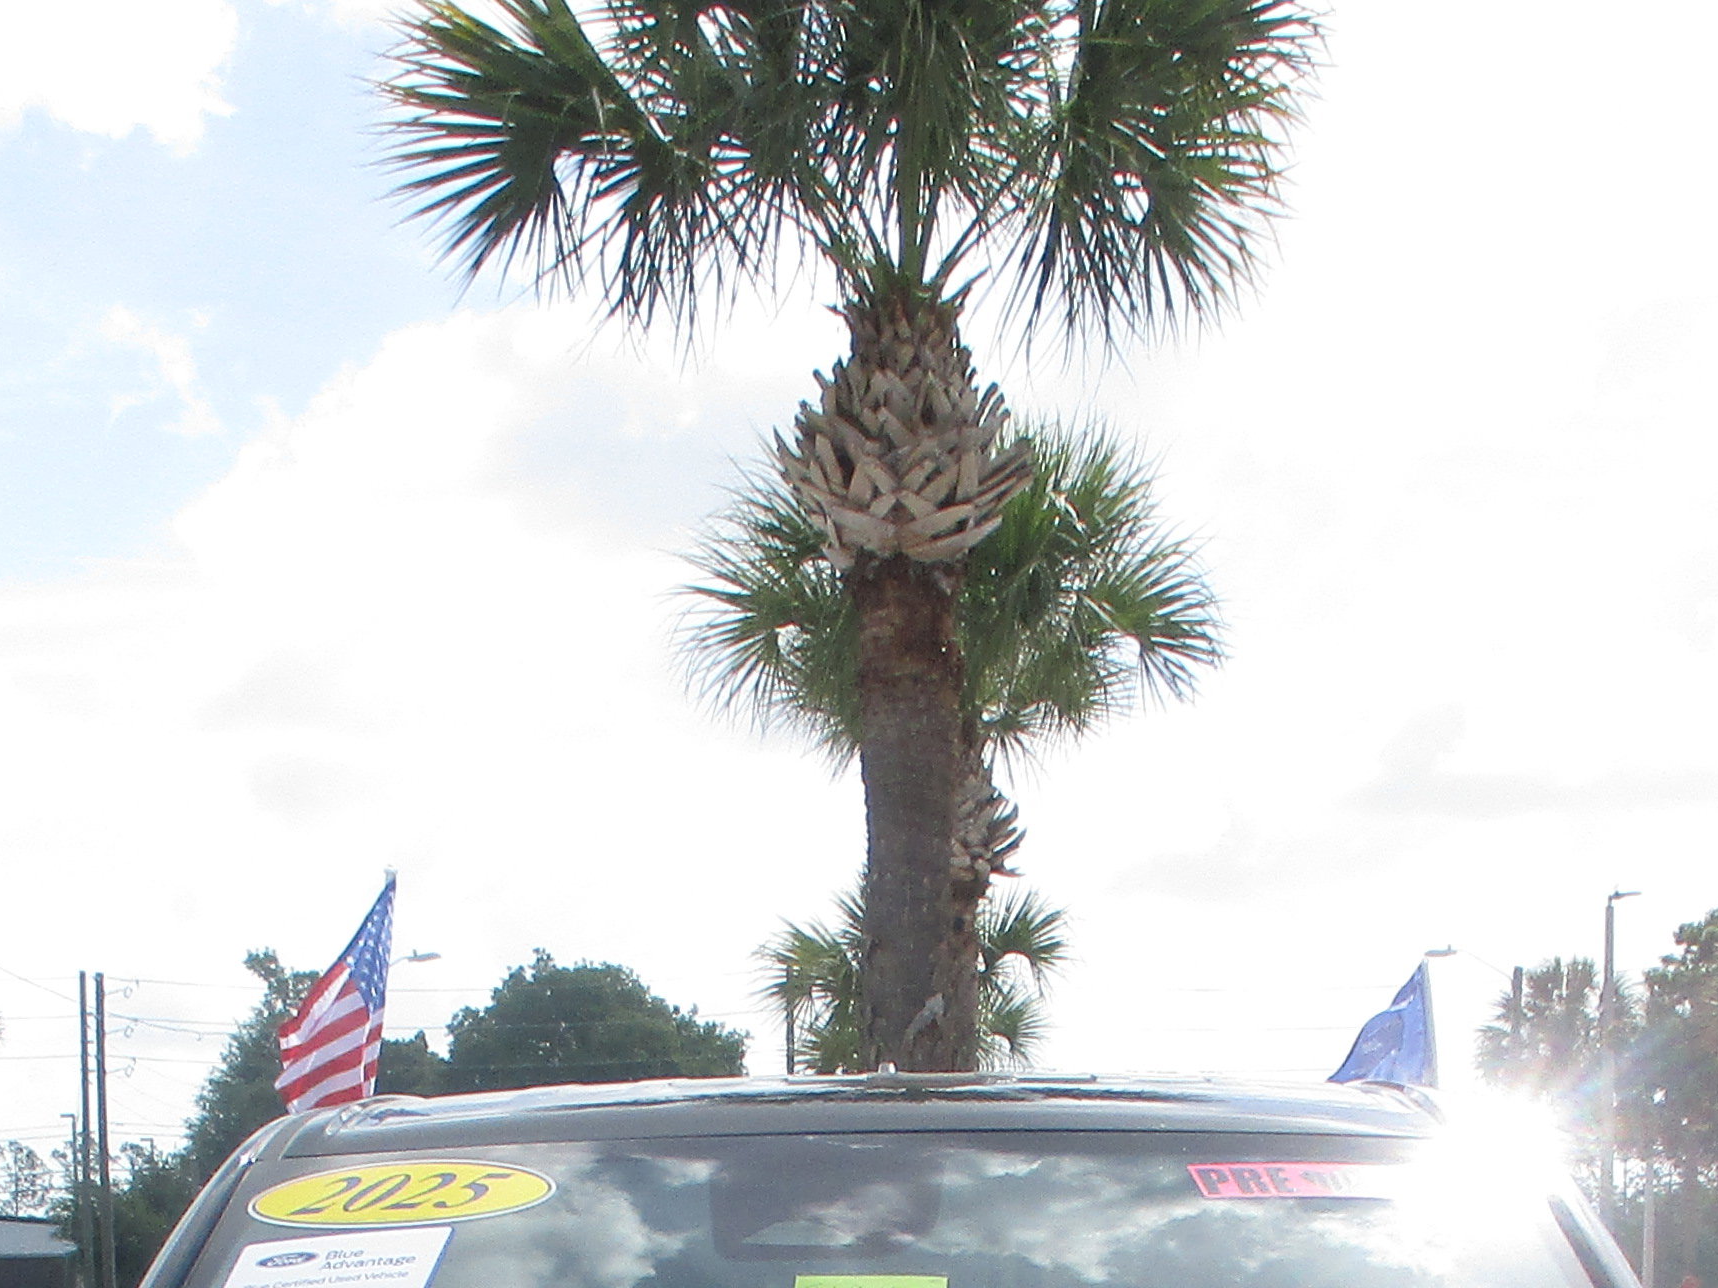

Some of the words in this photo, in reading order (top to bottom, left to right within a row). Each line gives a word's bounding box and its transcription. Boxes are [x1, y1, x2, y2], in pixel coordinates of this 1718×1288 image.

[286, 1172, 515, 1216] 2025
[319, 1254, 417, 1270] Advantage
[325, 1249, 364, 1260] Blue
[273, 1276, 326, 1288] Certified
[328, 1273, 361, 1284] Used
[364, 1270, 409, 1281] Vehicle
